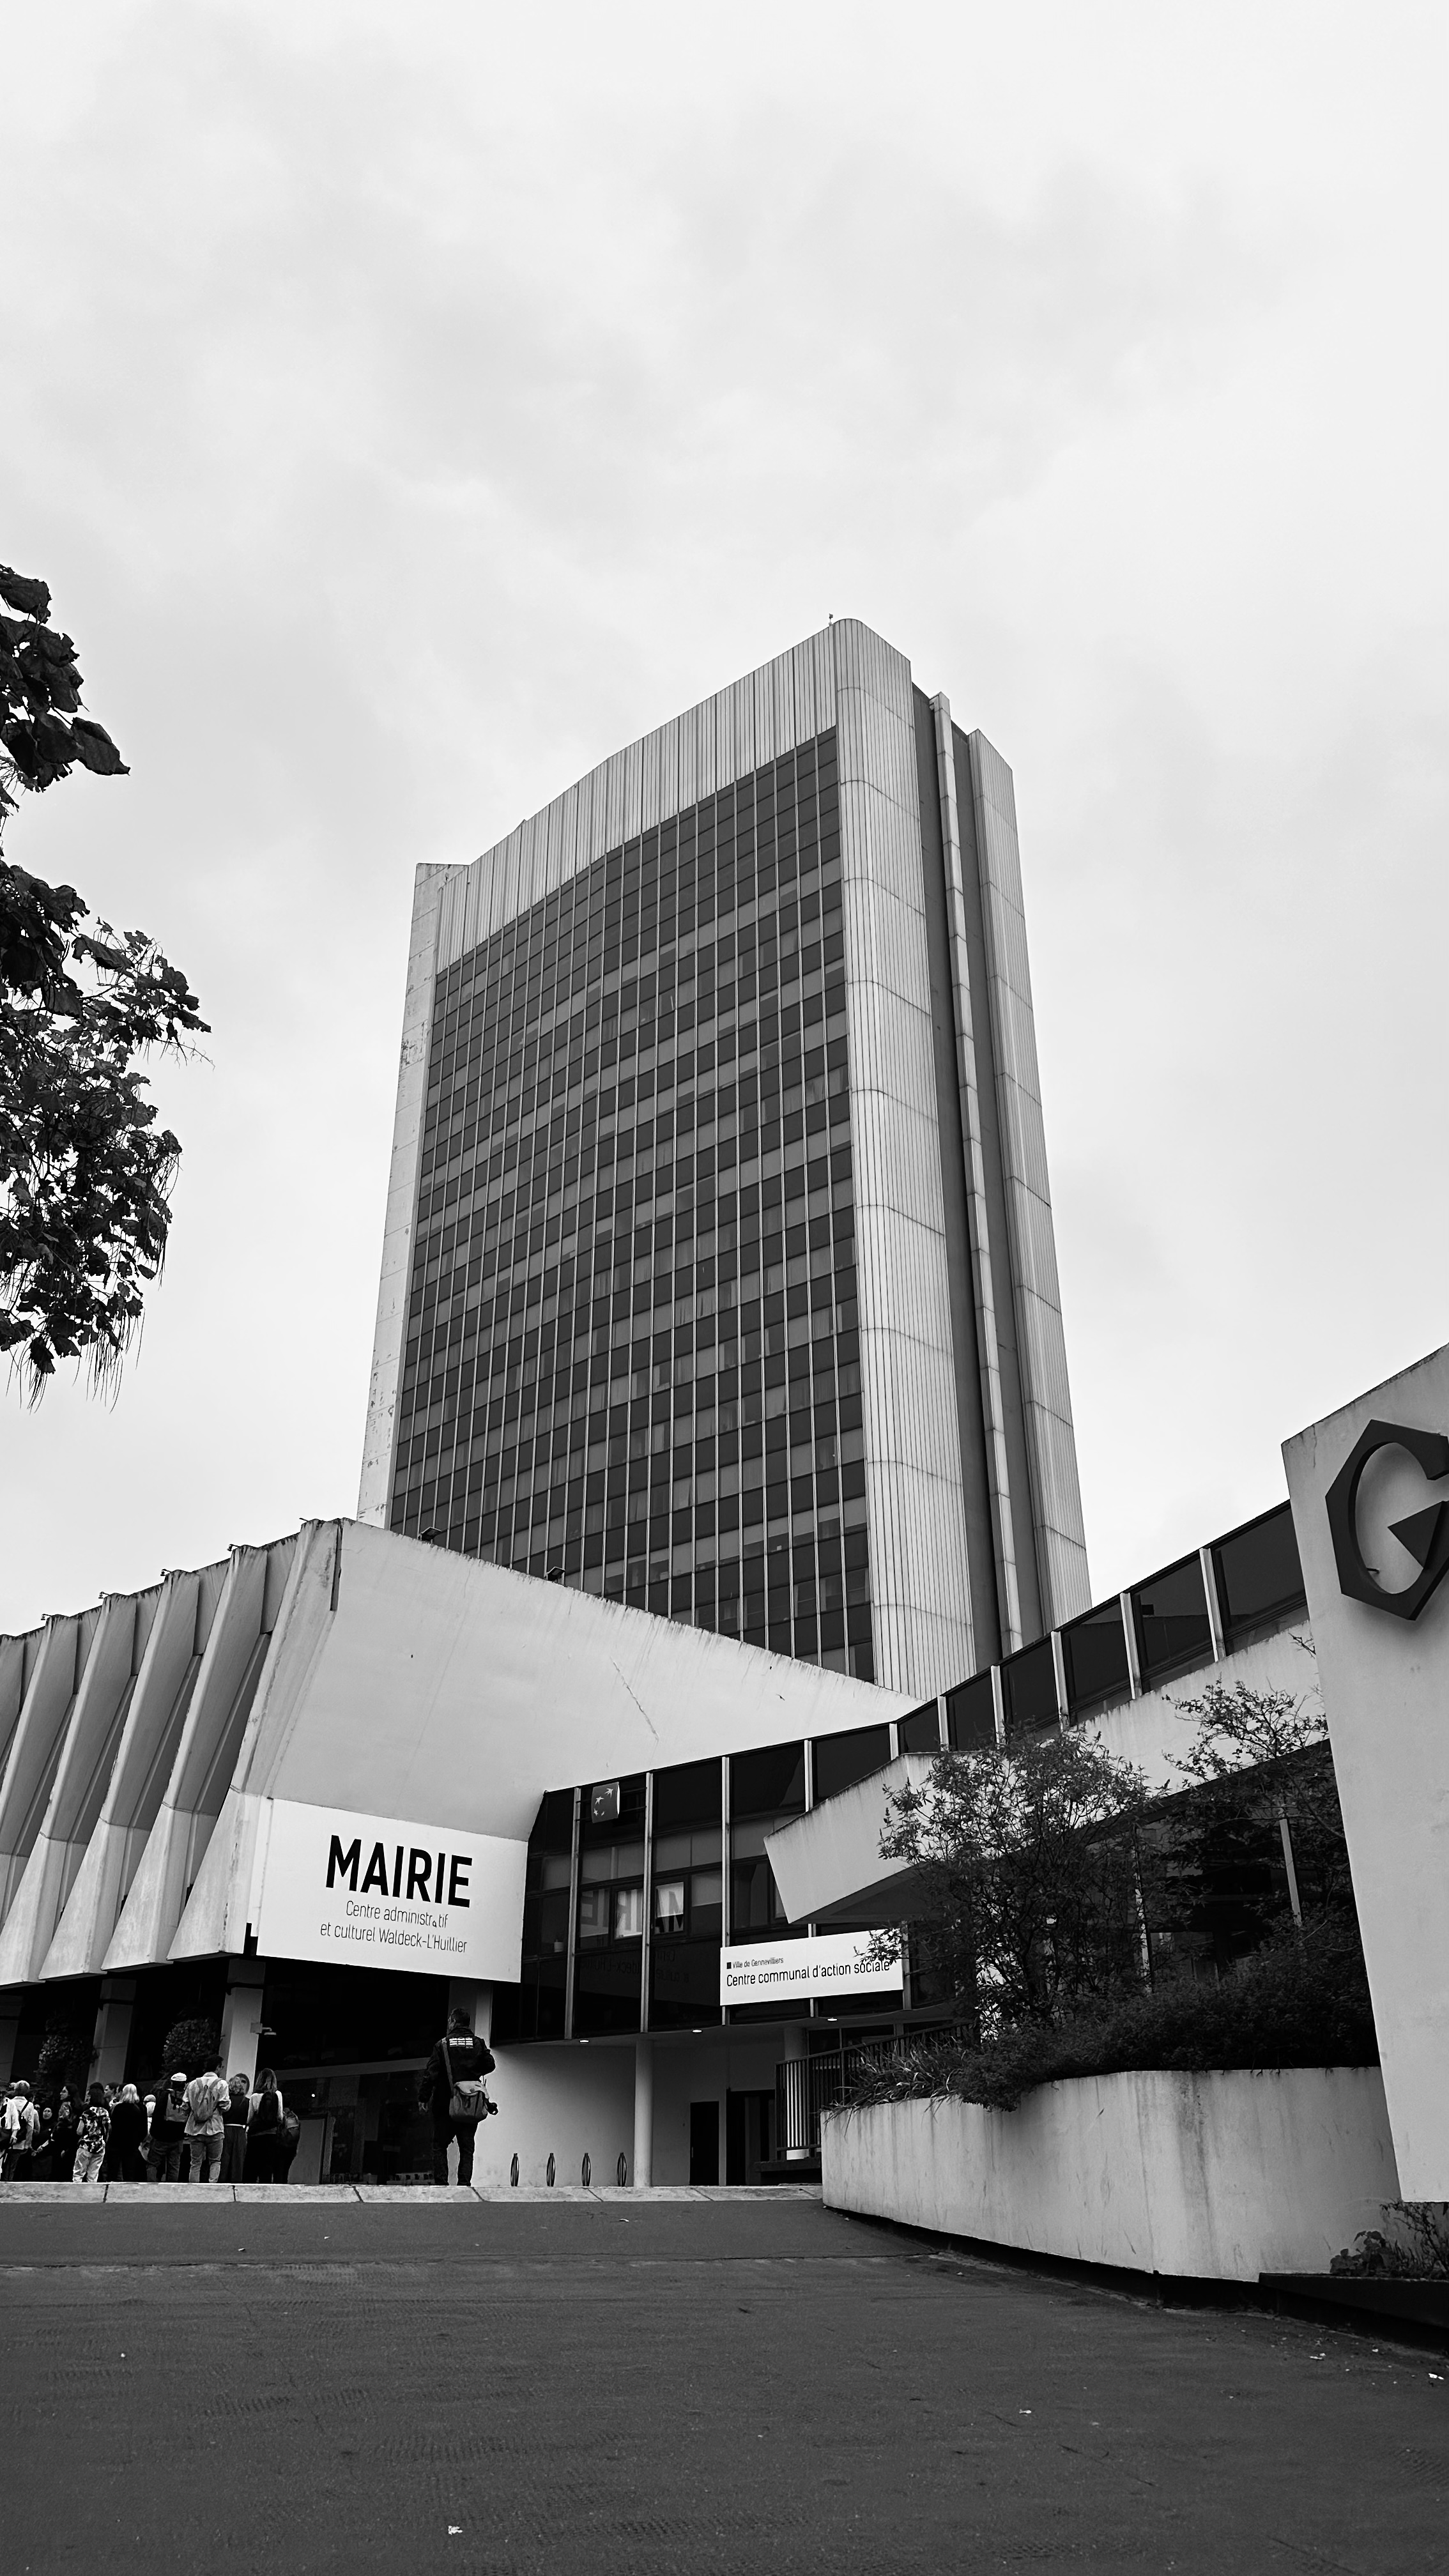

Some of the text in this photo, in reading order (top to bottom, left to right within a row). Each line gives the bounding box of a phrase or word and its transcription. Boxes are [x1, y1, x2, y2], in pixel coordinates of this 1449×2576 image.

[326, 1835, 473, 1908] MAIRIE
[346, 1900, 381, 1919] Centre
[320, 1922, 468, 1952] et culturel Waldeck-L'Huillier
[726, 1959, 890, 1987] Centre communal d'action sociale
[732, 1961, 743, 1969] Ville
[744, 1959, 750, 1968] de
